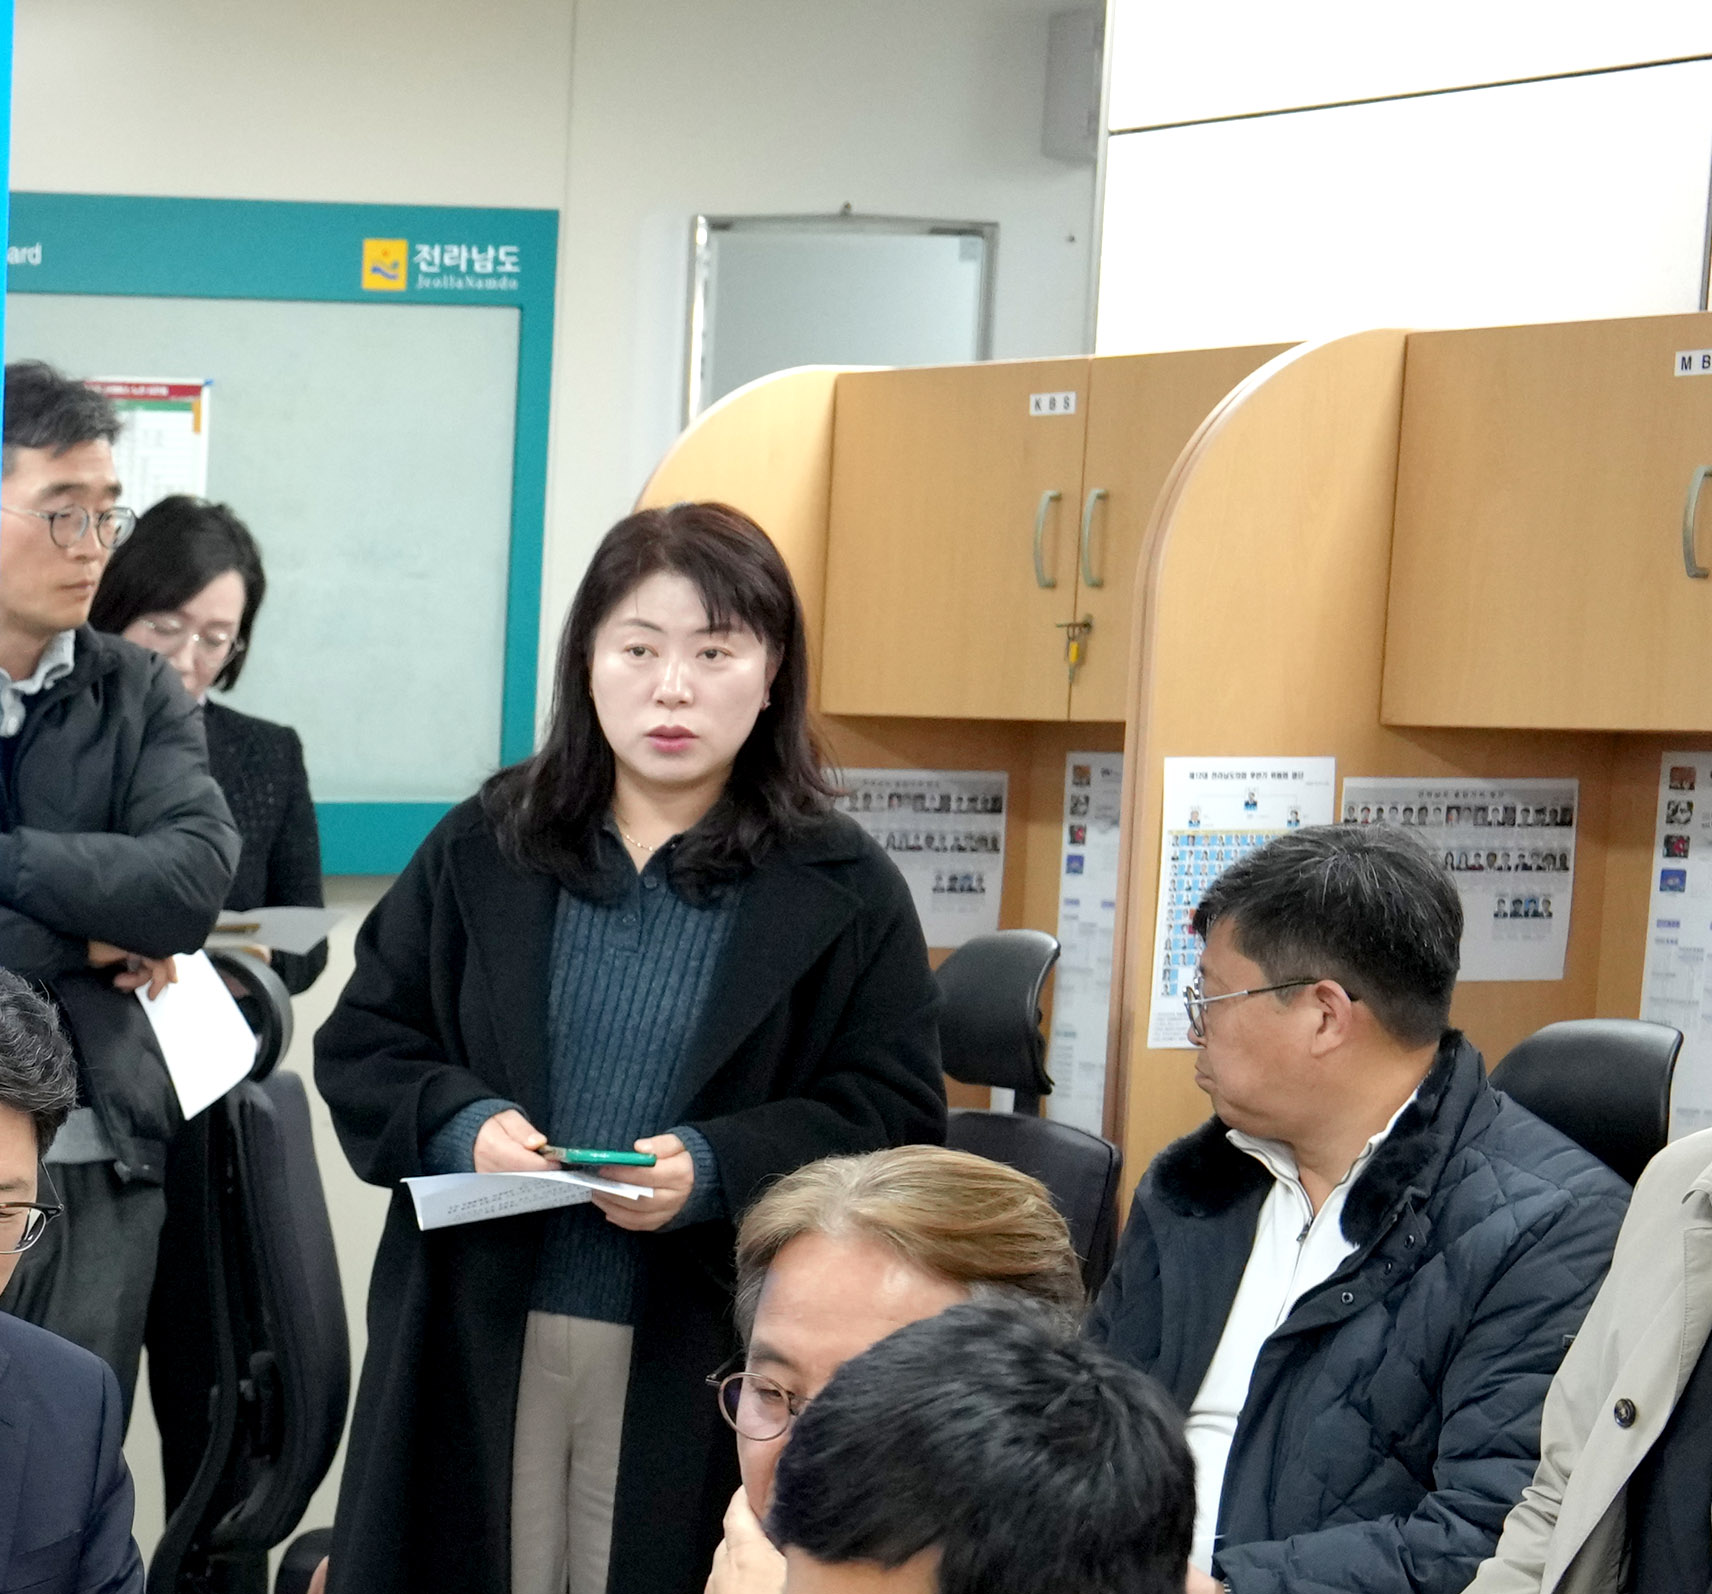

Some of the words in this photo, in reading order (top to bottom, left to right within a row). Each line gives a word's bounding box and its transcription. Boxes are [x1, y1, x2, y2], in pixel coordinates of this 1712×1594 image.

[8, 242, 43, 266] ard
[413, 244, 521, 274] 전라남도
[1680, 354, 1712, 372] MB
